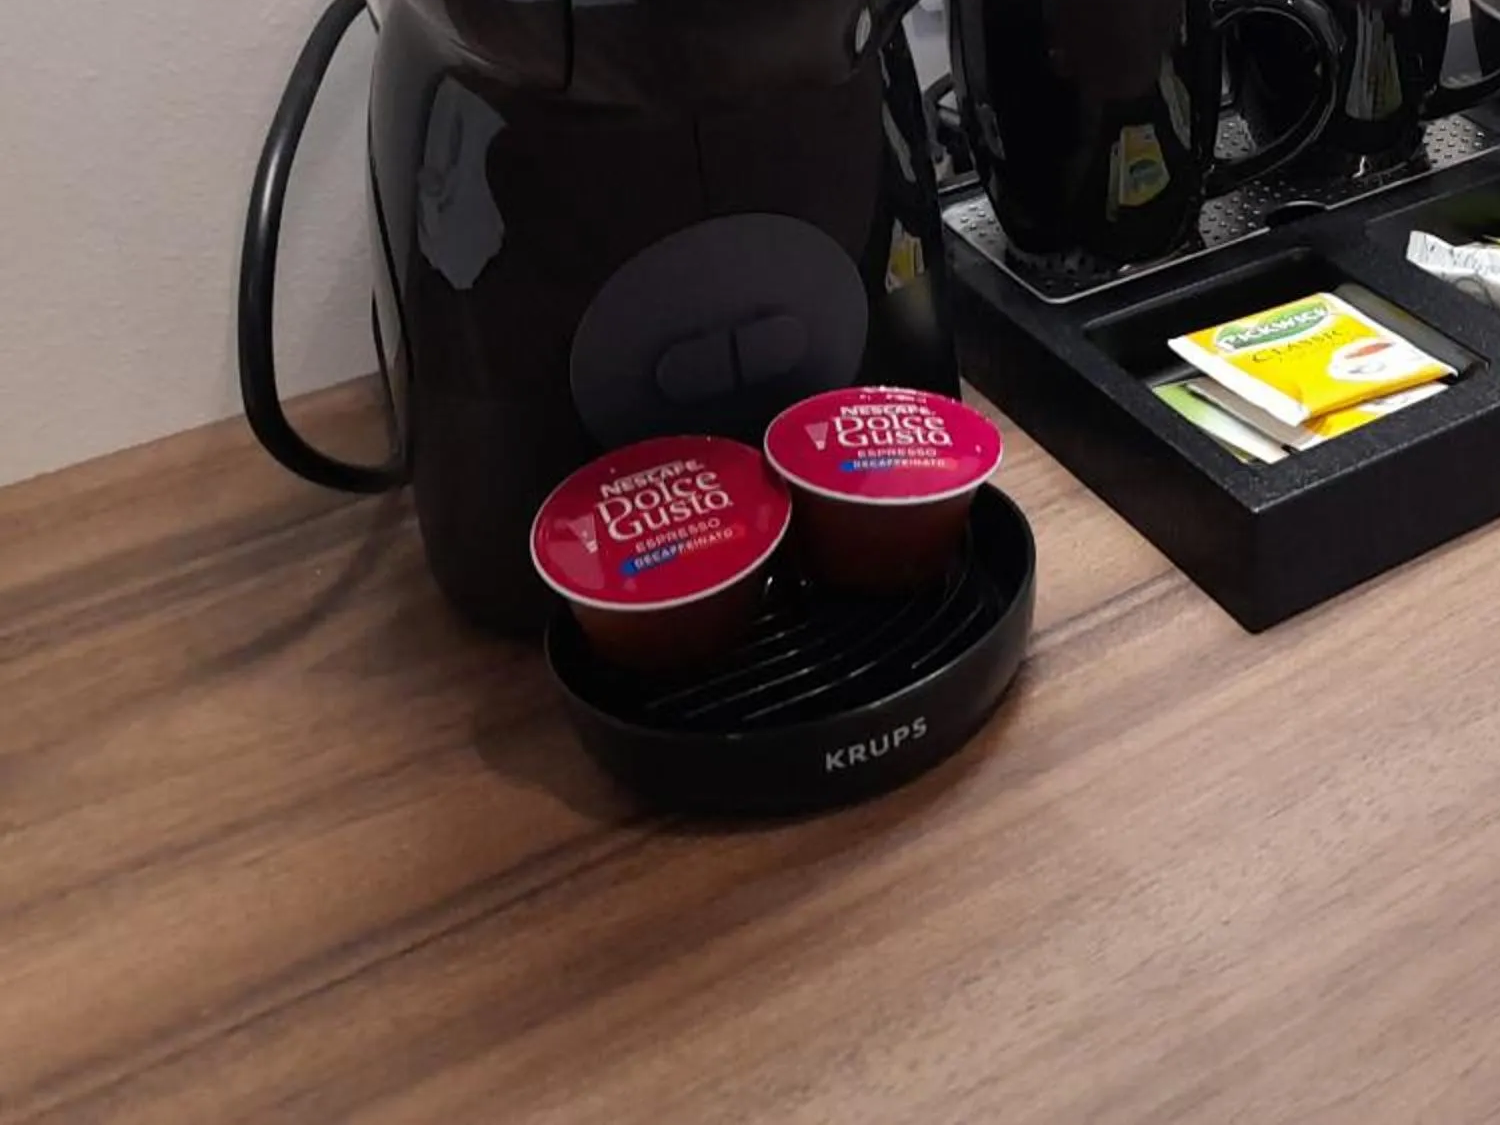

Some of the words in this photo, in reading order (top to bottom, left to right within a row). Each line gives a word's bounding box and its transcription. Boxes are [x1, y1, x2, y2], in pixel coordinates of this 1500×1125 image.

[833, 414, 946, 433] Dolce
[837, 426, 953, 448] Gusto
[857, 447, 937, 458] ESPRESSO
[595, 471, 721, 525] Dolce
[607, 490, 735, 542] Gusto
[635, 517, 721, 554] ESPRESSO
[825, 716, 927, 772] KRUPS
